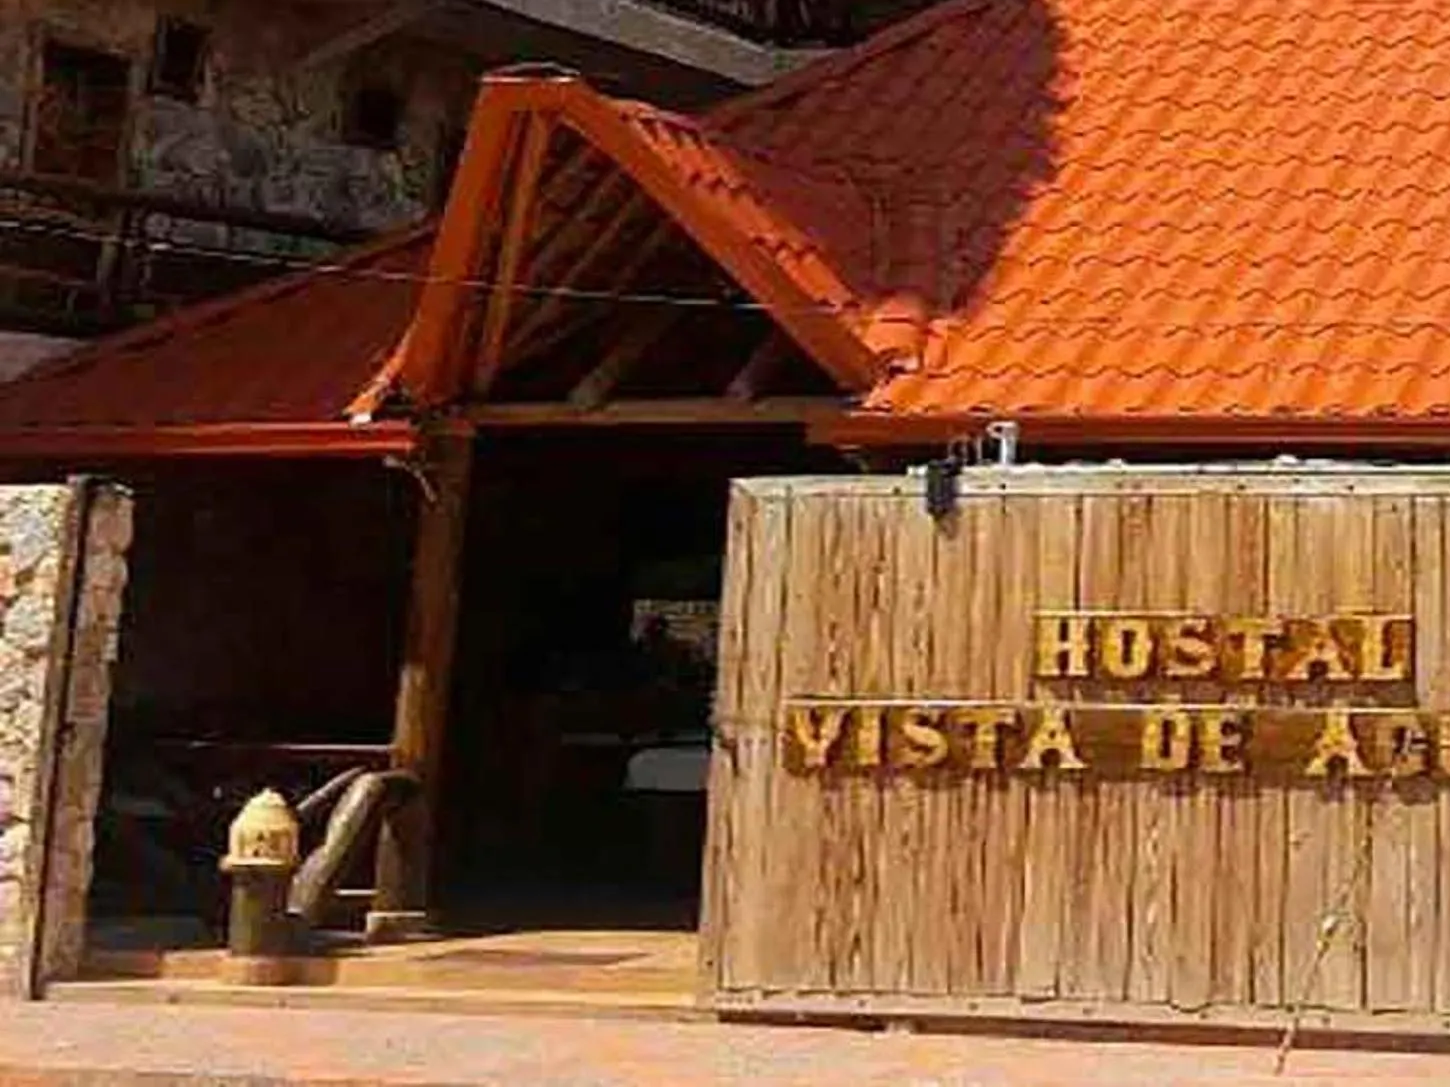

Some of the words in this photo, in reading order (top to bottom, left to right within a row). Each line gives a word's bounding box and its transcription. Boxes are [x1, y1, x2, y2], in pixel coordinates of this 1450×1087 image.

[1036, 615, 1412, 681] HOSTAL
[790, 708, 1088, 769] VISTA
[1141, 710, 1244, 771] DE
